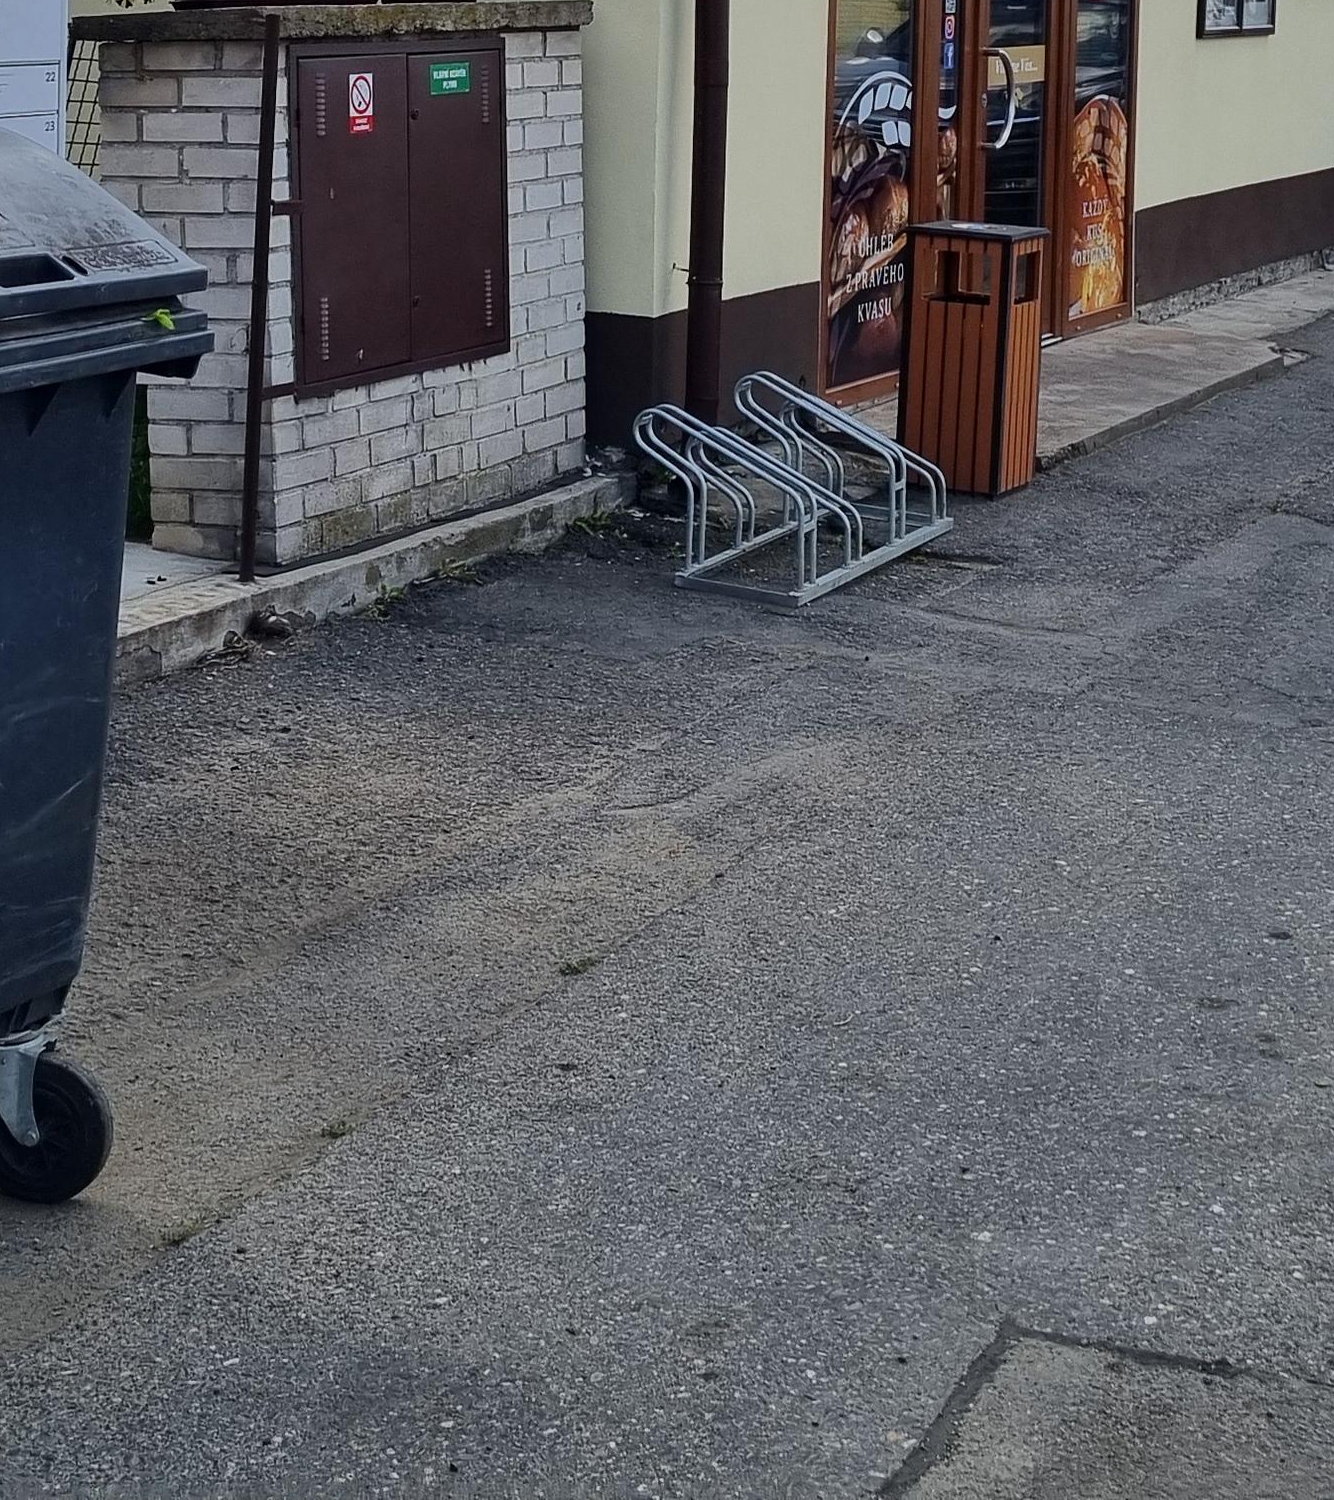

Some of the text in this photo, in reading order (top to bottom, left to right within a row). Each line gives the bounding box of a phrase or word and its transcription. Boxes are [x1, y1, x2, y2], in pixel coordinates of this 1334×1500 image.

[45, 71, 56, 82] 22
[44, 121, 55, 132] 23
[857, 297, 892, 323] KVASU
